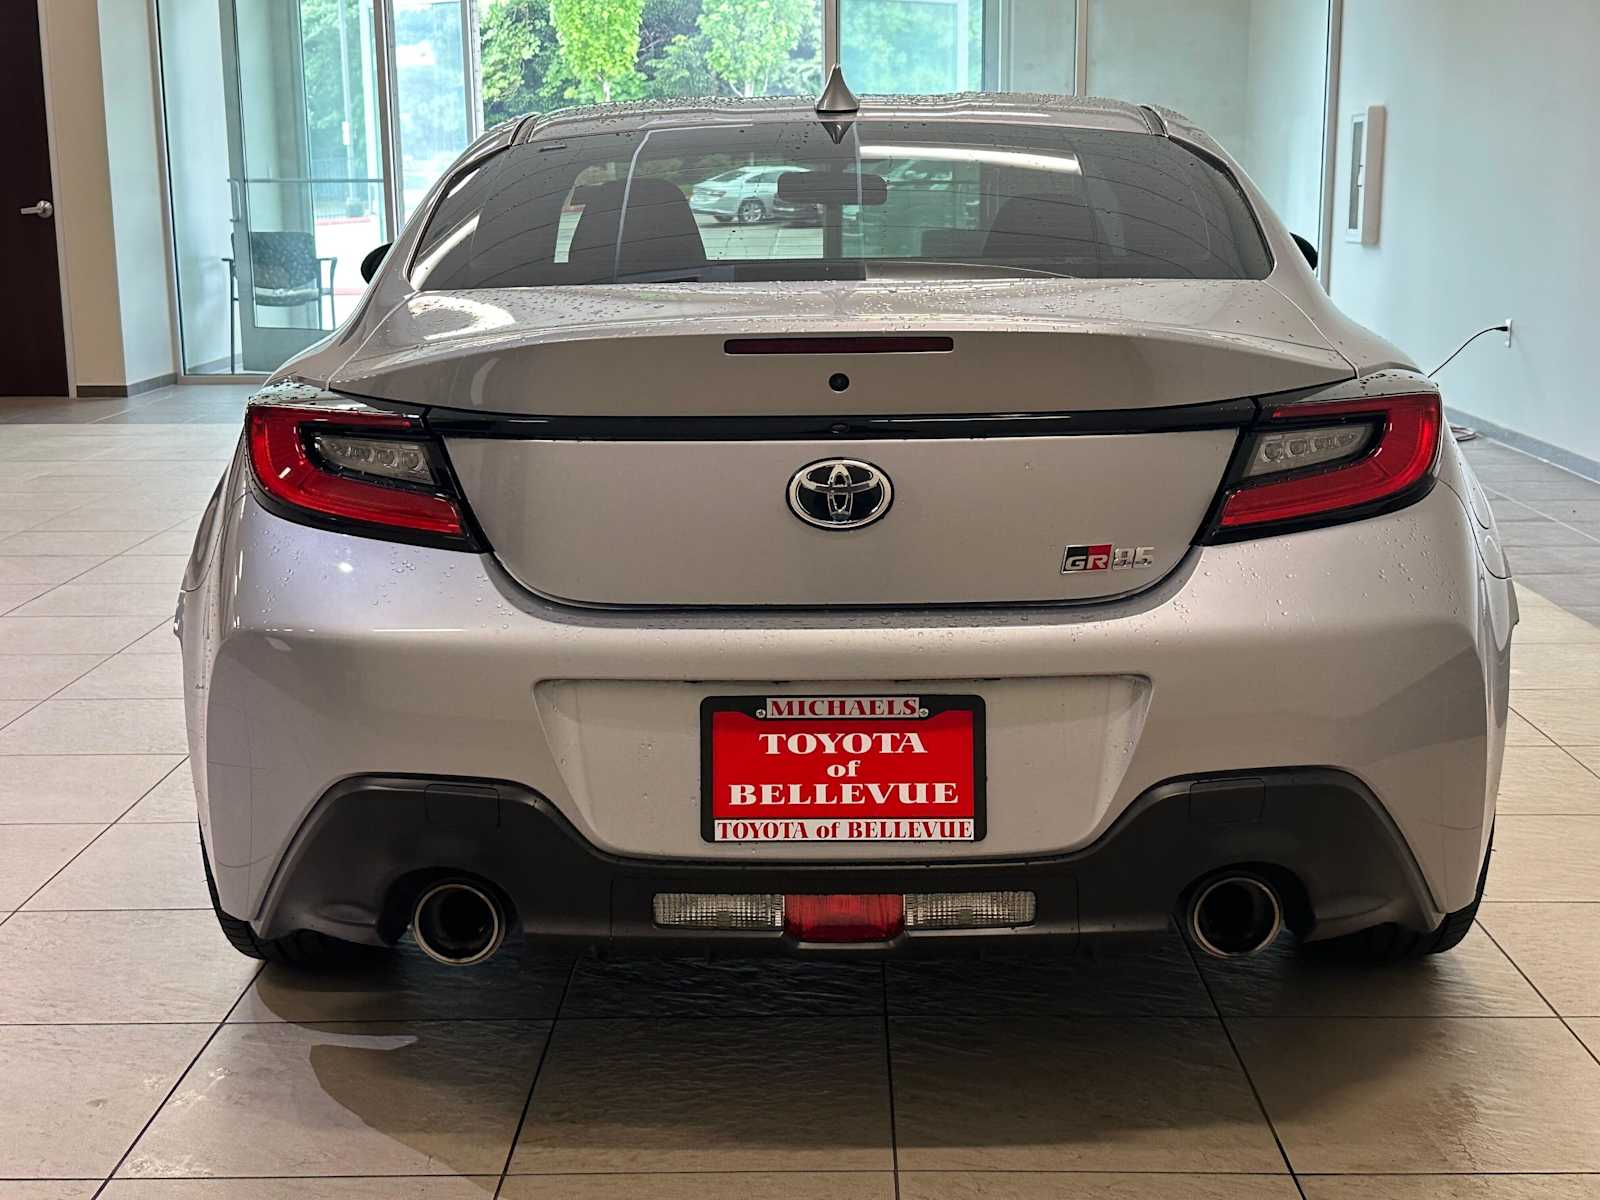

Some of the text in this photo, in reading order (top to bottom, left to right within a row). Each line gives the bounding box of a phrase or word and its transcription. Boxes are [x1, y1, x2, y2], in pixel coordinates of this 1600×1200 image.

[771, 699, 917, 717] MICHAELS
[758, 732, 928, 755] TOYOTA
[826, 760, 861, 778] of
[728, 782, 959, 806] BELLEVUE
[717, 821, 973, 840] TOYOTA of BELLEVUE
